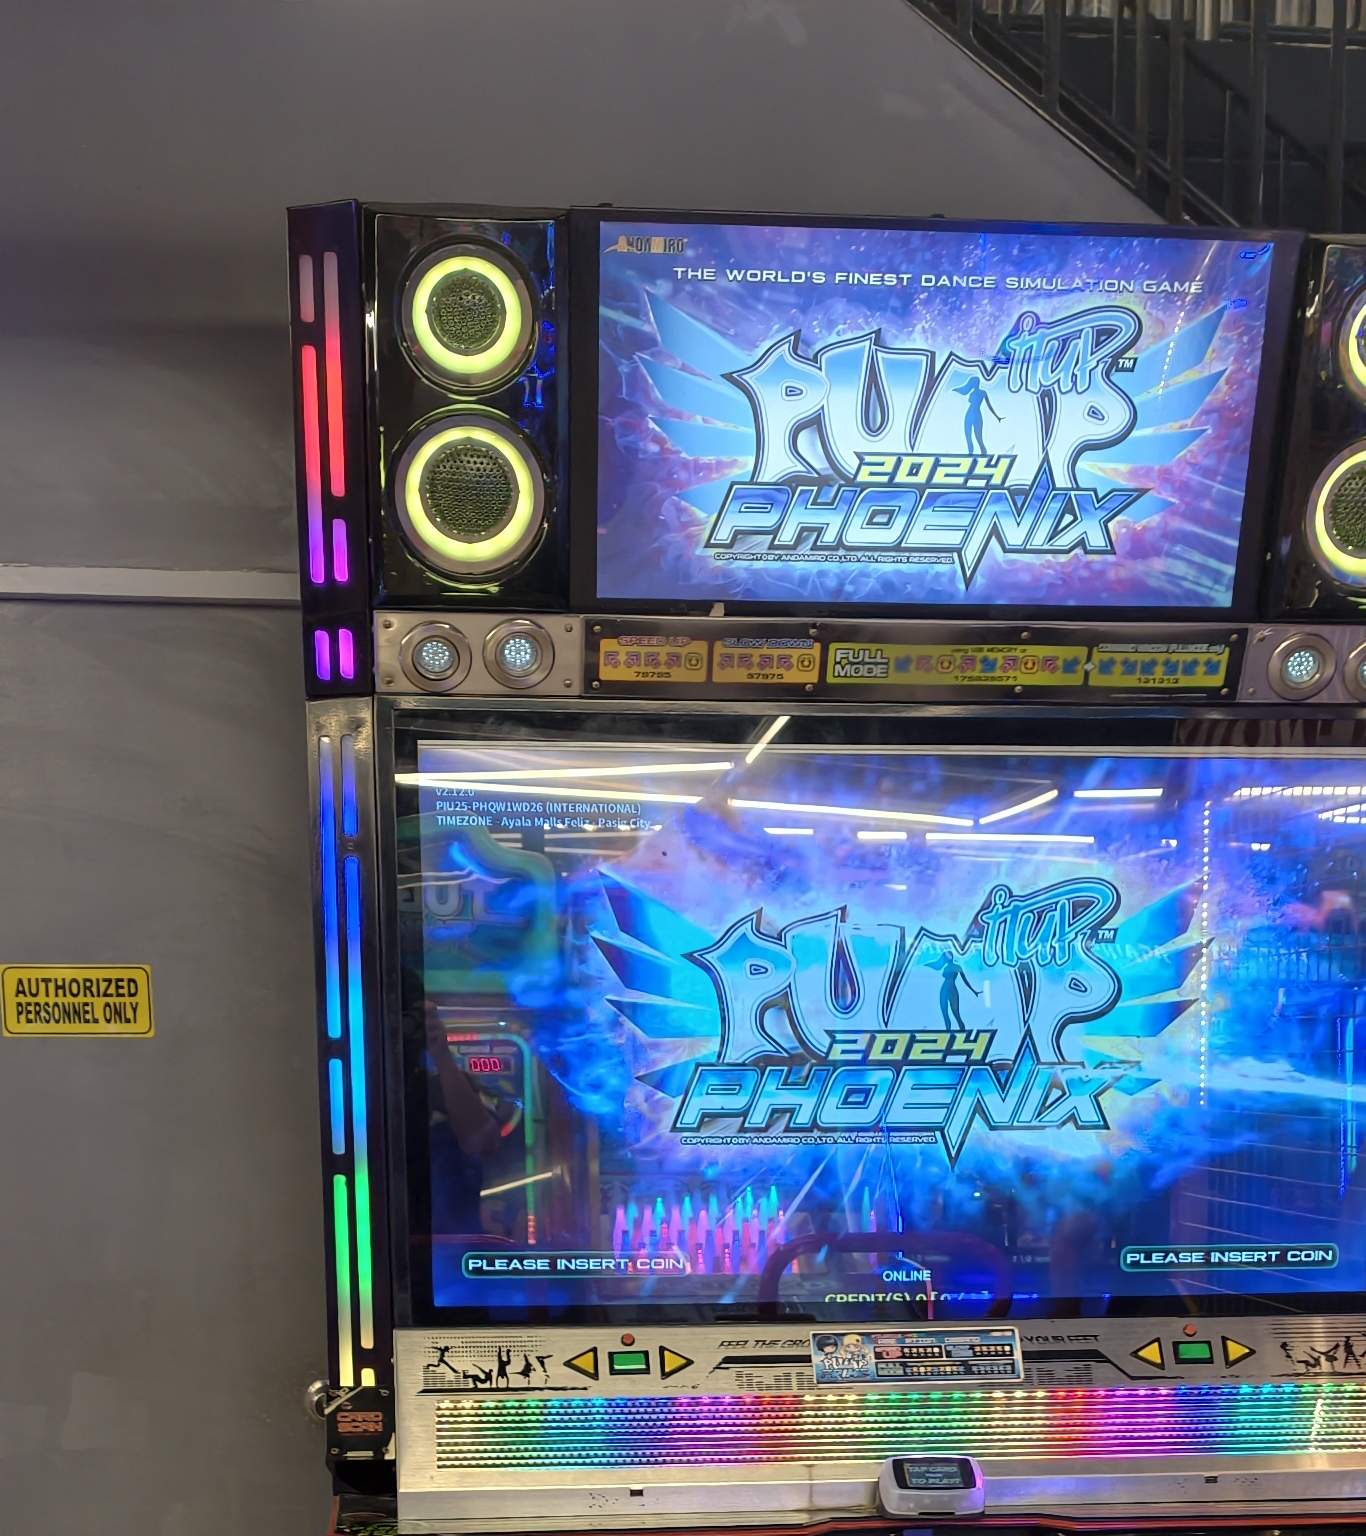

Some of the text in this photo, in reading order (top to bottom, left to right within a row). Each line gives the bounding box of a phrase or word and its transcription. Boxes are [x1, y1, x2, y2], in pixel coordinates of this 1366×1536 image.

[673, 267, 1203, 294] THE WORLD'S FINEST DANCE SIMULATION GAME
[725, 331, 1137, 488] PUMP
[856, 456, 1013, 485] 2024
[706, 470, 1150, 588] PHOENIX
[878, 555, 908, 564] RIGHTS
[618, 636, 692, 647] SPEED UP
[834, 648, 890, 663] FULL
[833, 663, 889, 679] MODE
[546, 801, 642, 815] (INTERNATIONAL)
[436, 815, 493, 827] TIMEZONE
[501, 816, 532, 829] Ayala
[630, 817, 651, 831] City
[14, 977, 140, 998] AUTHORIZED
[683, 908, 1120, 1064] PUMP
[15, 1001, 140, 1024] PERSONNEL ONLY
[828, 1029, 991, 1062] 2024
[672, 1050, 1132, 1169] PHOENIX
[468, 1257, 685, 1271] PLEASE INSERT COIN
[1126, 1250, 1334, 1264] PLEASE INSERT COIN
[882, 1270, 932, 1283] ONLINE
